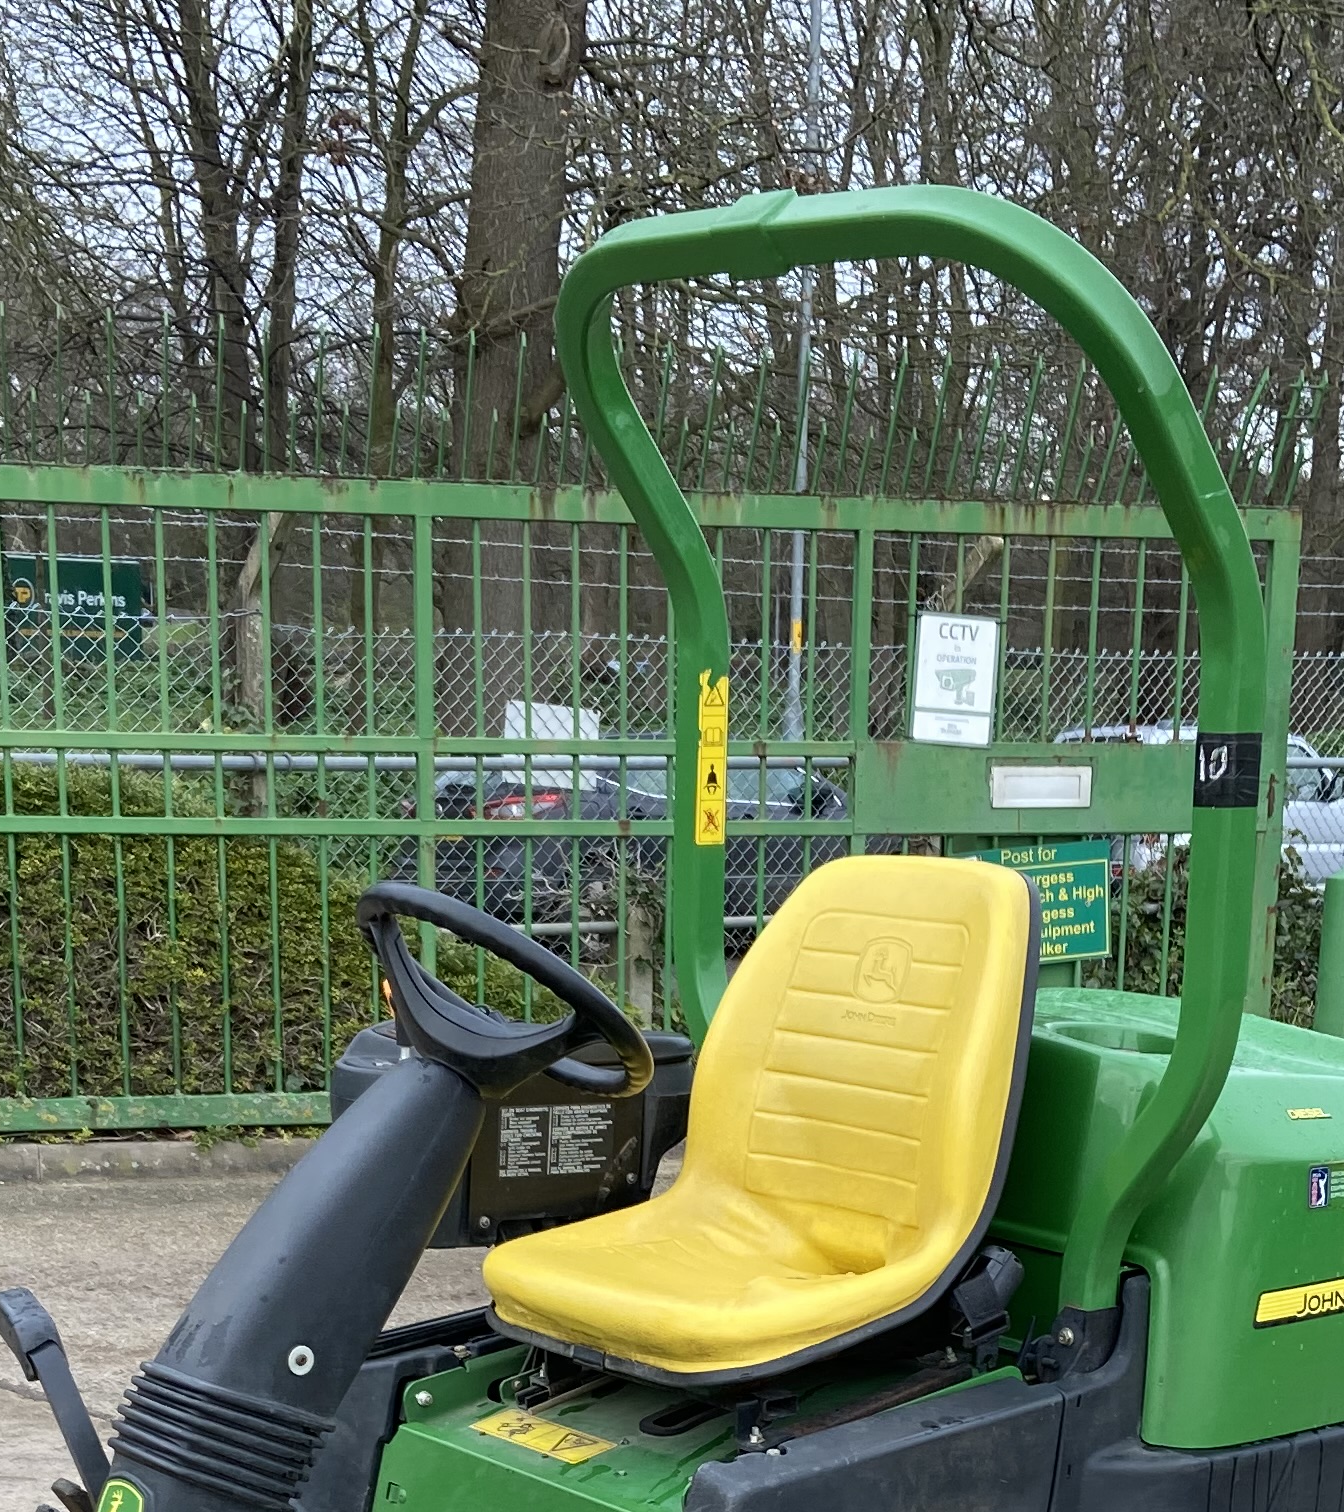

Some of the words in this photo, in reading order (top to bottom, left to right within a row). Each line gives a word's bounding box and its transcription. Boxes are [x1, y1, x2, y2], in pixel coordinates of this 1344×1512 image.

[939, 623, 979, 641] CCTV
[937, 654, 977, 665] OPERATION
[1001, 850, 1034, 864] Post
[1038, 847, 1058, 862] for
[1058, 887, 1069, 901] &
[1072, 884, 1104, 903] High
